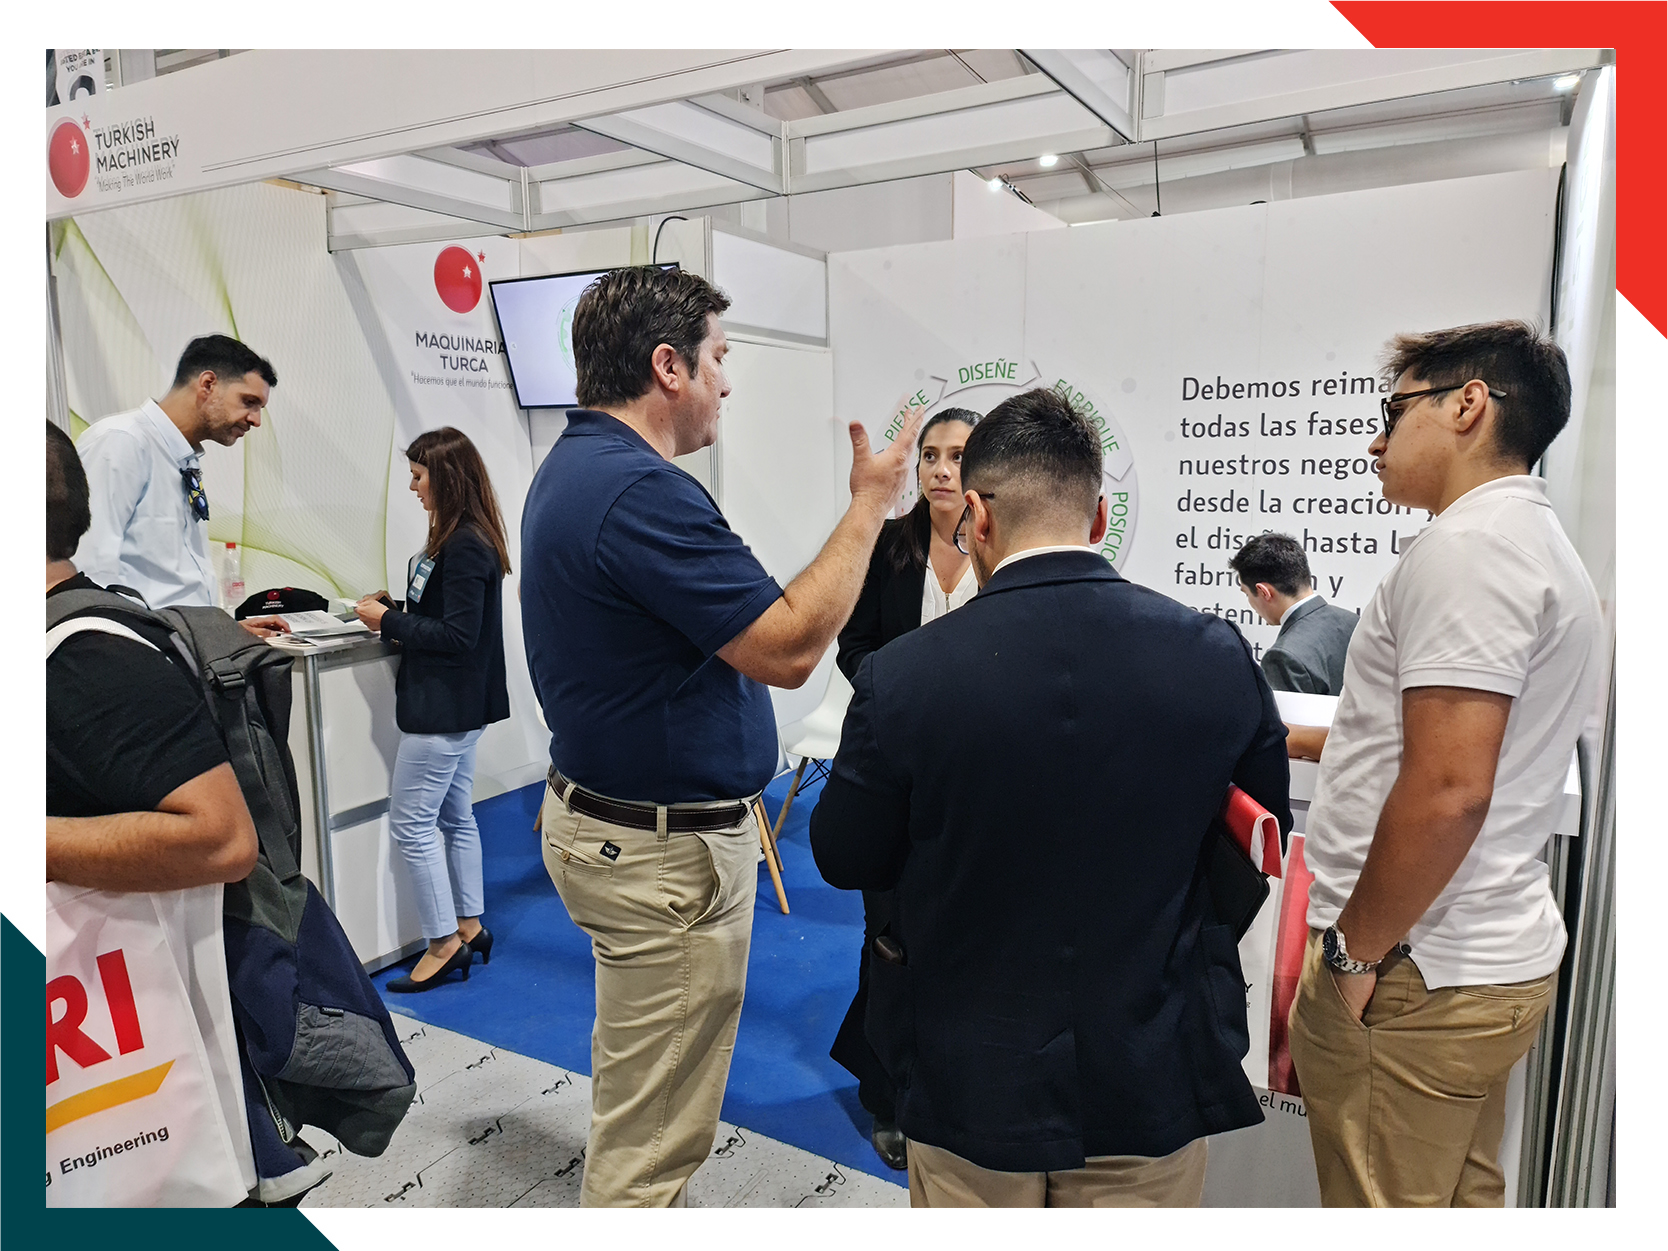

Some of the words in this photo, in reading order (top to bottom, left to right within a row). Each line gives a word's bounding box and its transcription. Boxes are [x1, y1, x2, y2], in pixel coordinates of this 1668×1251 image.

[94, 119, 155, 150] TURKISH
[96, 138, 180, 174] MACHINERY
[415, 331, 507, 355] MAQUINARIA
[440, 354, 489, 373] TURCA
[958, 358, 1018, 385] DISEÑE
[446, 378, 458, 387] que
[459, 376, 465, 386] el
[466, 378, 487, 388] mundo
[1182, 375, 1301, 401] Debemos
[1311, 371, 1392, 397] reima
[1180, 413, 1250, 438] todas
[1260, 412, 1297, 437] las
[1308, 411, 1379, 436] fases
[1179, 454, 1290, 476] nuestros
[1300, 457, 1380, 480] negoc
[1177, 489, 1250, 513] desde
[1260, 489, 1282, 514] la
[1100, 491, 1128, 563] POSICIO
[1176, 526, 1198, 549] el
[1303, 528, 1378, 554] hasta
[1328, 575, 1344, 598] y
[1259, 1092, 1275, 1109] el
[1280, 1101, 1308, 1118] mu
[59, 1126, 170, 1175] Engineering
